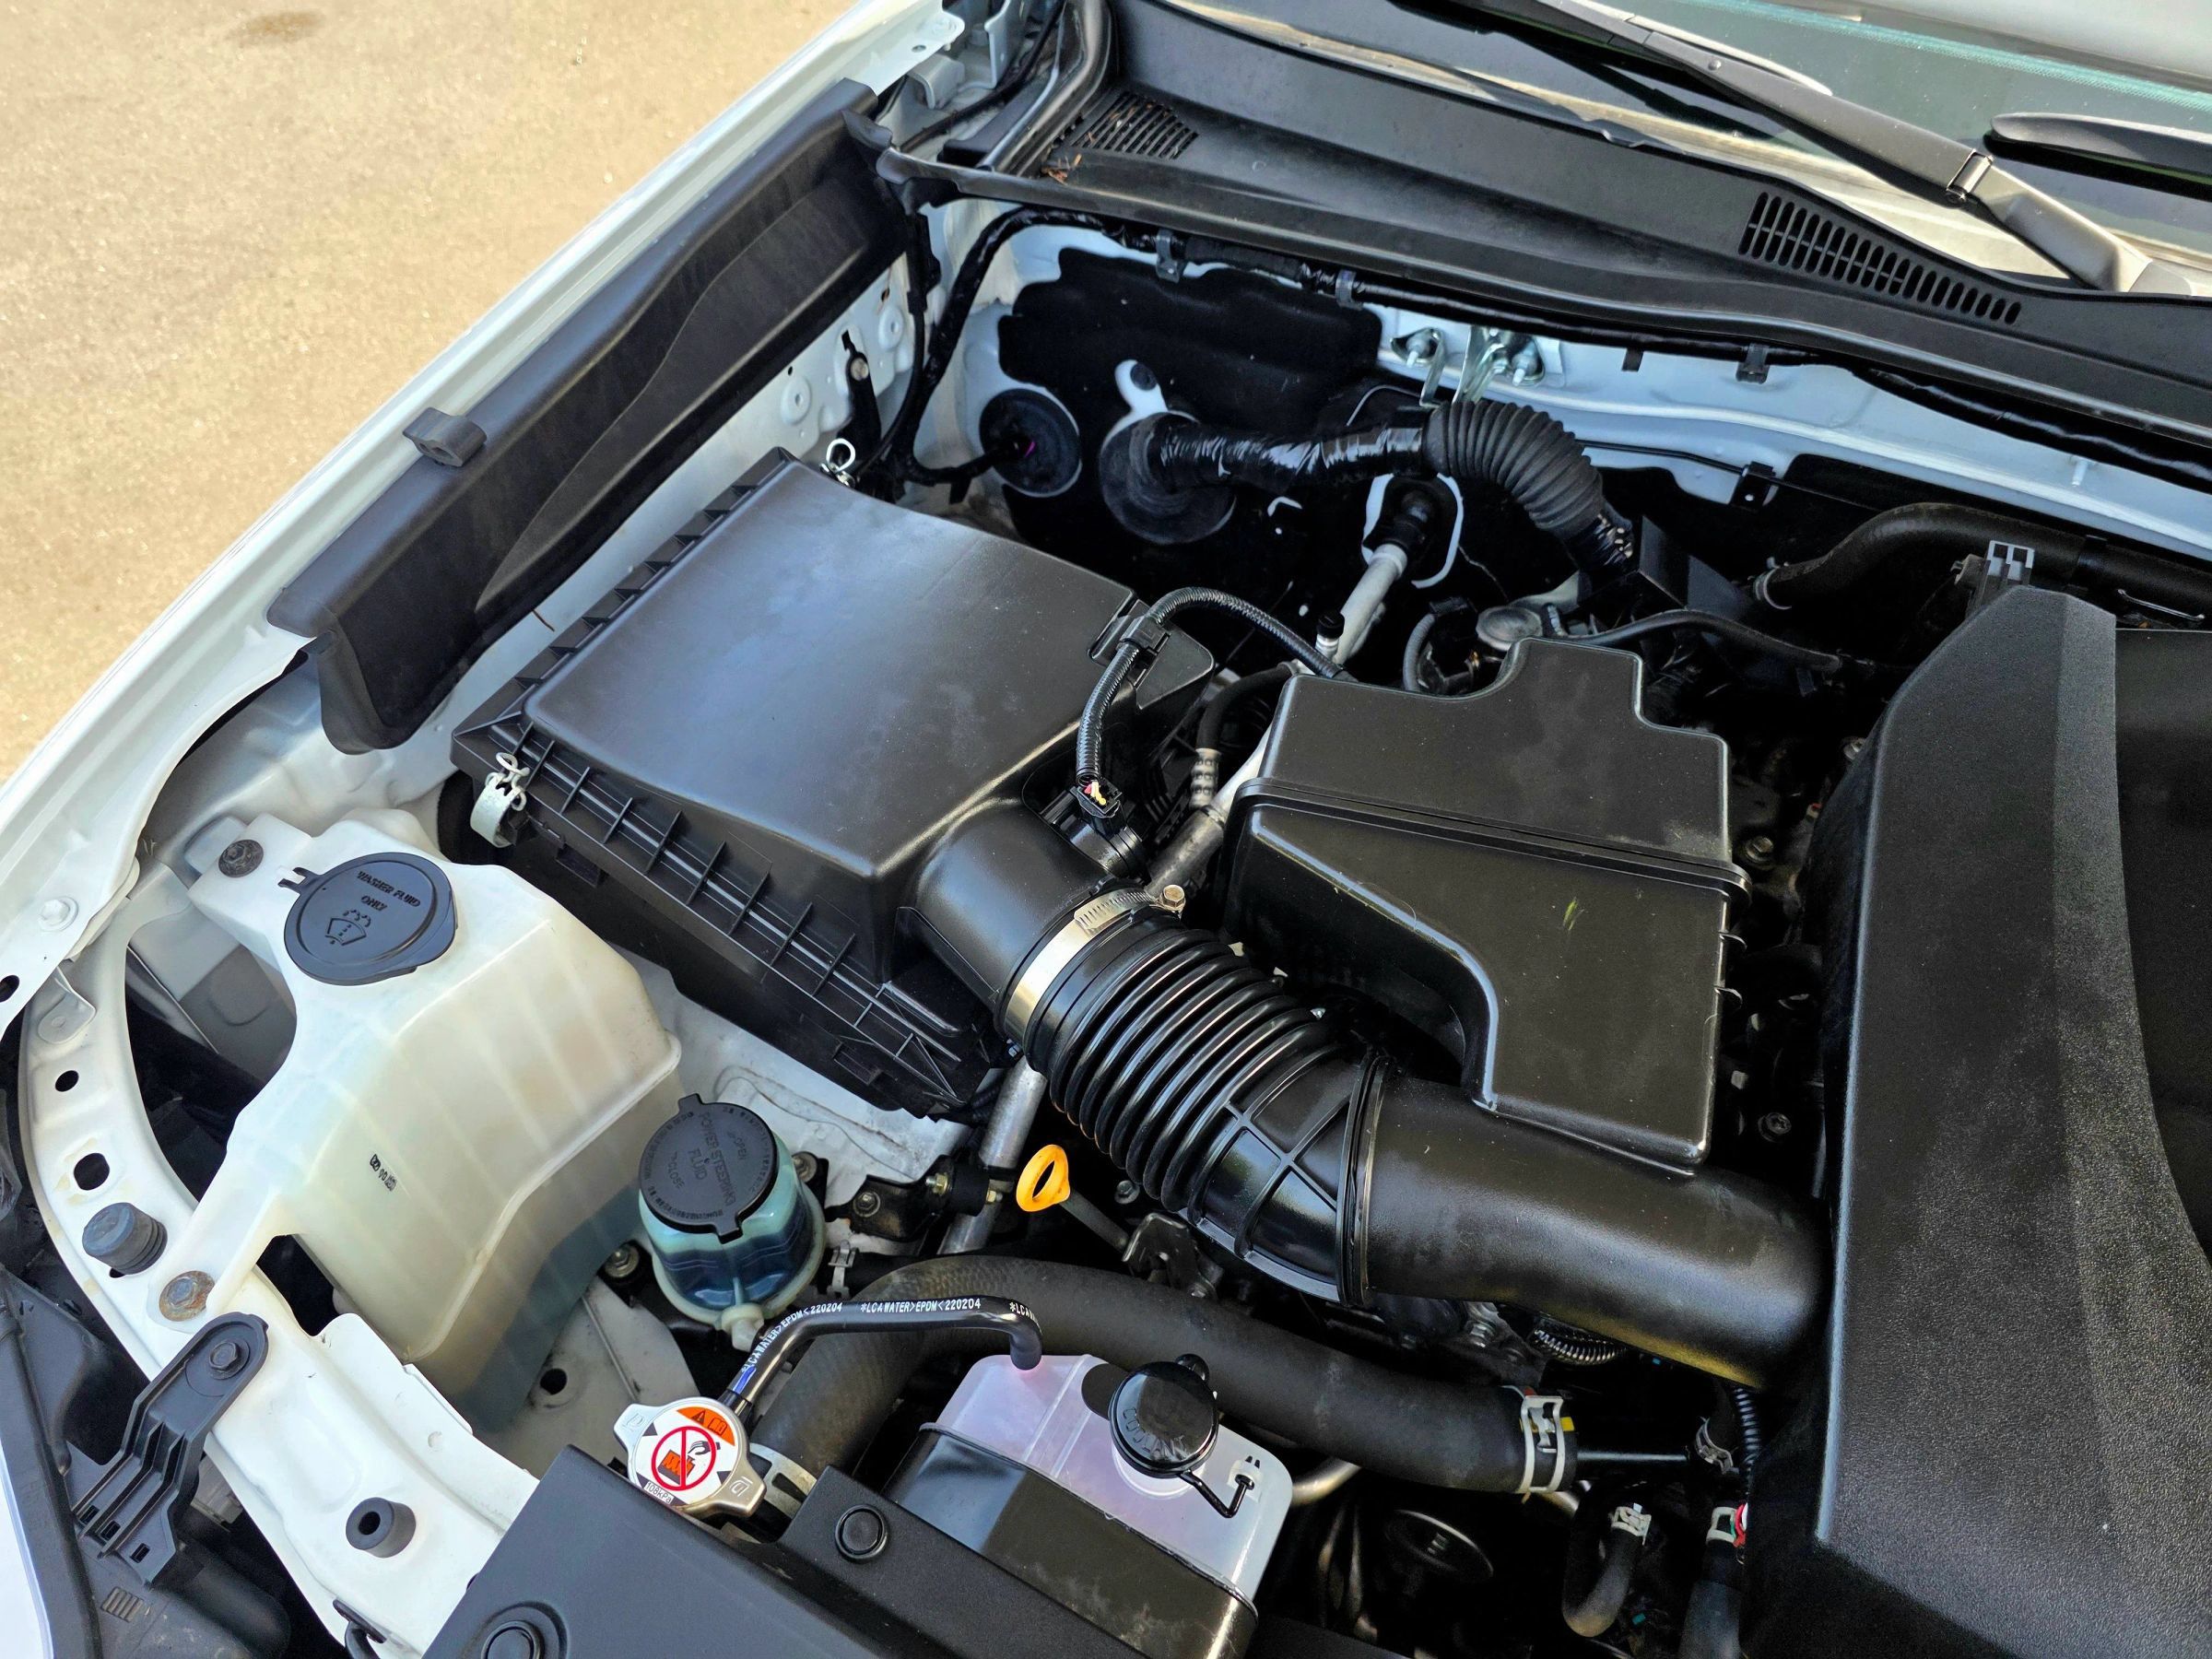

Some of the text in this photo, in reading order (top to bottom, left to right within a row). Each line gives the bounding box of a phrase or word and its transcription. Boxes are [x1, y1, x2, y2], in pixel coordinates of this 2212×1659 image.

[357, 871, 421, 907] WASHER FLUID
[360, 895, 388, 912] ONLY
[667, 1161, 686, 1190] CLOSE
[688, 1147, 708, 1181] FLUID
[699, 1112, 737, 1206] POWER STEERING
[1123, 1407, 1188, 1461] COOLANT
[646, 1481, 672, 1503] 108kPa
